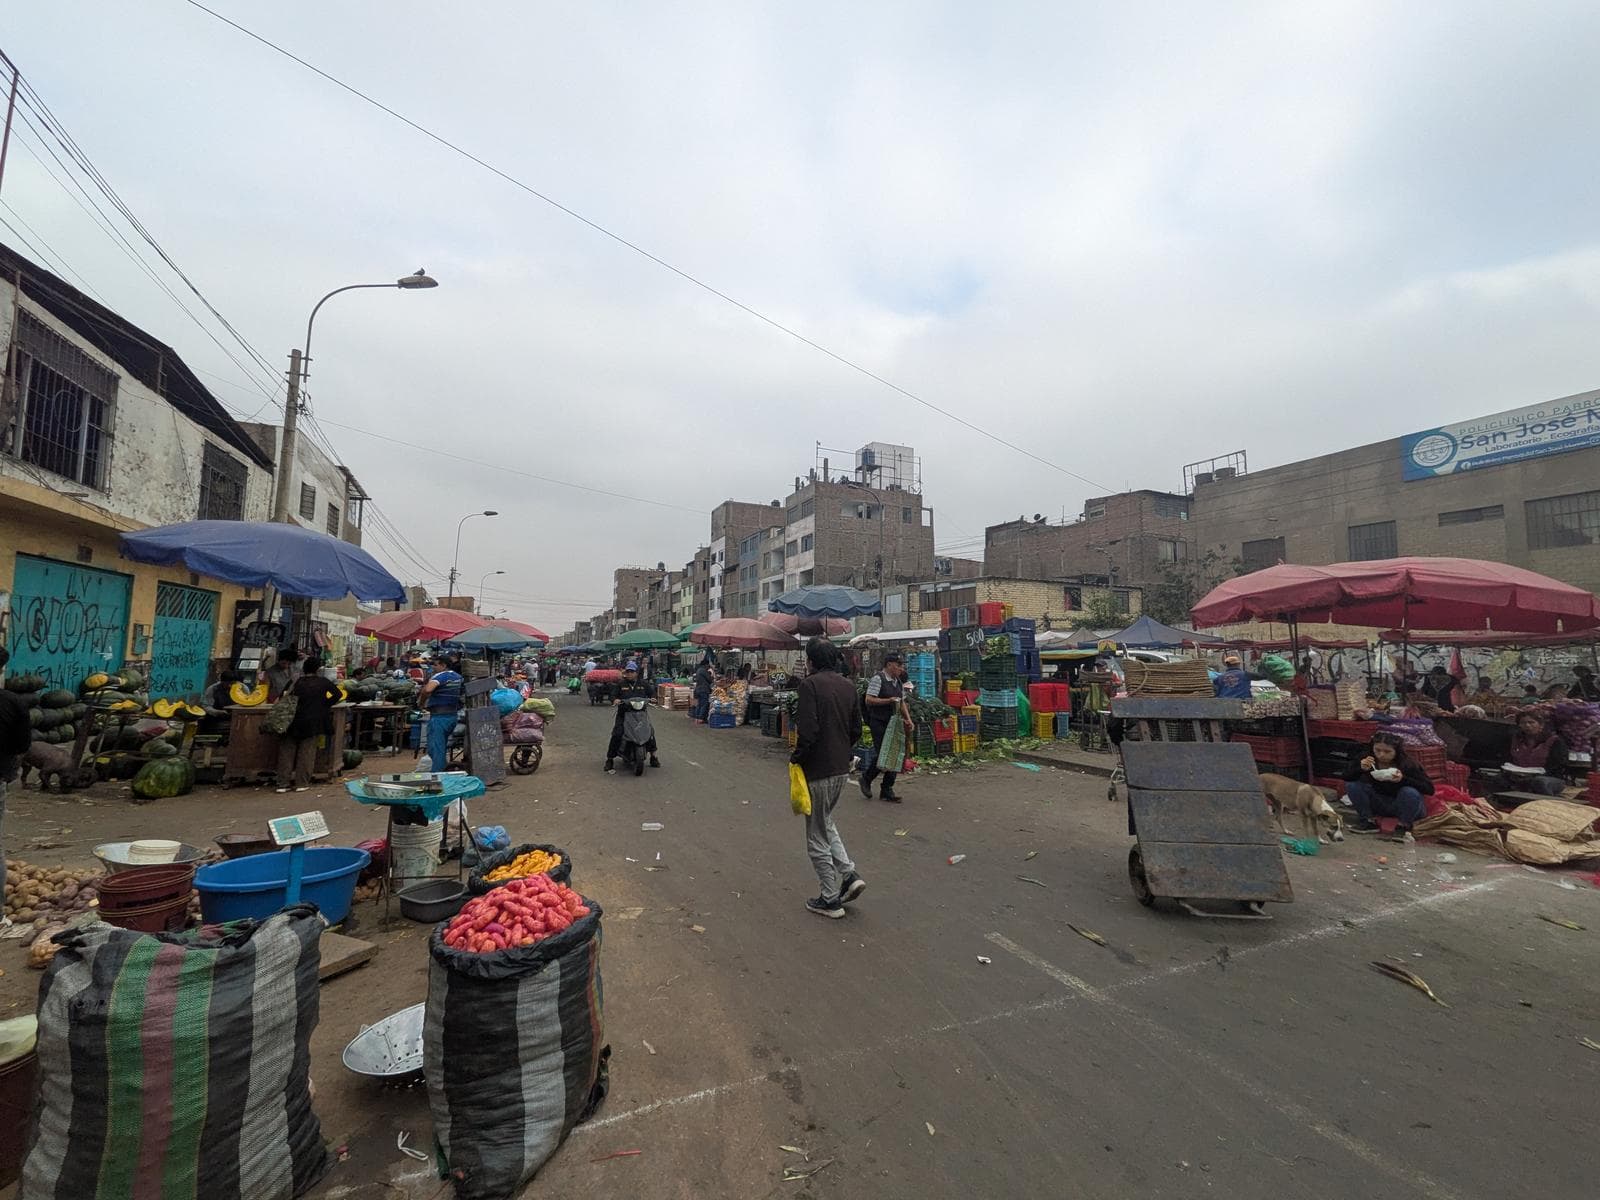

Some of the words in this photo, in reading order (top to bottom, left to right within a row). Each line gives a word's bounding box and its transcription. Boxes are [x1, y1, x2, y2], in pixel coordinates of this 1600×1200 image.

[1460, 431, 1507, 451] San
[1516, 410, 1577, 438] José
[1484, 436, 1542, 453] Laboratorio
